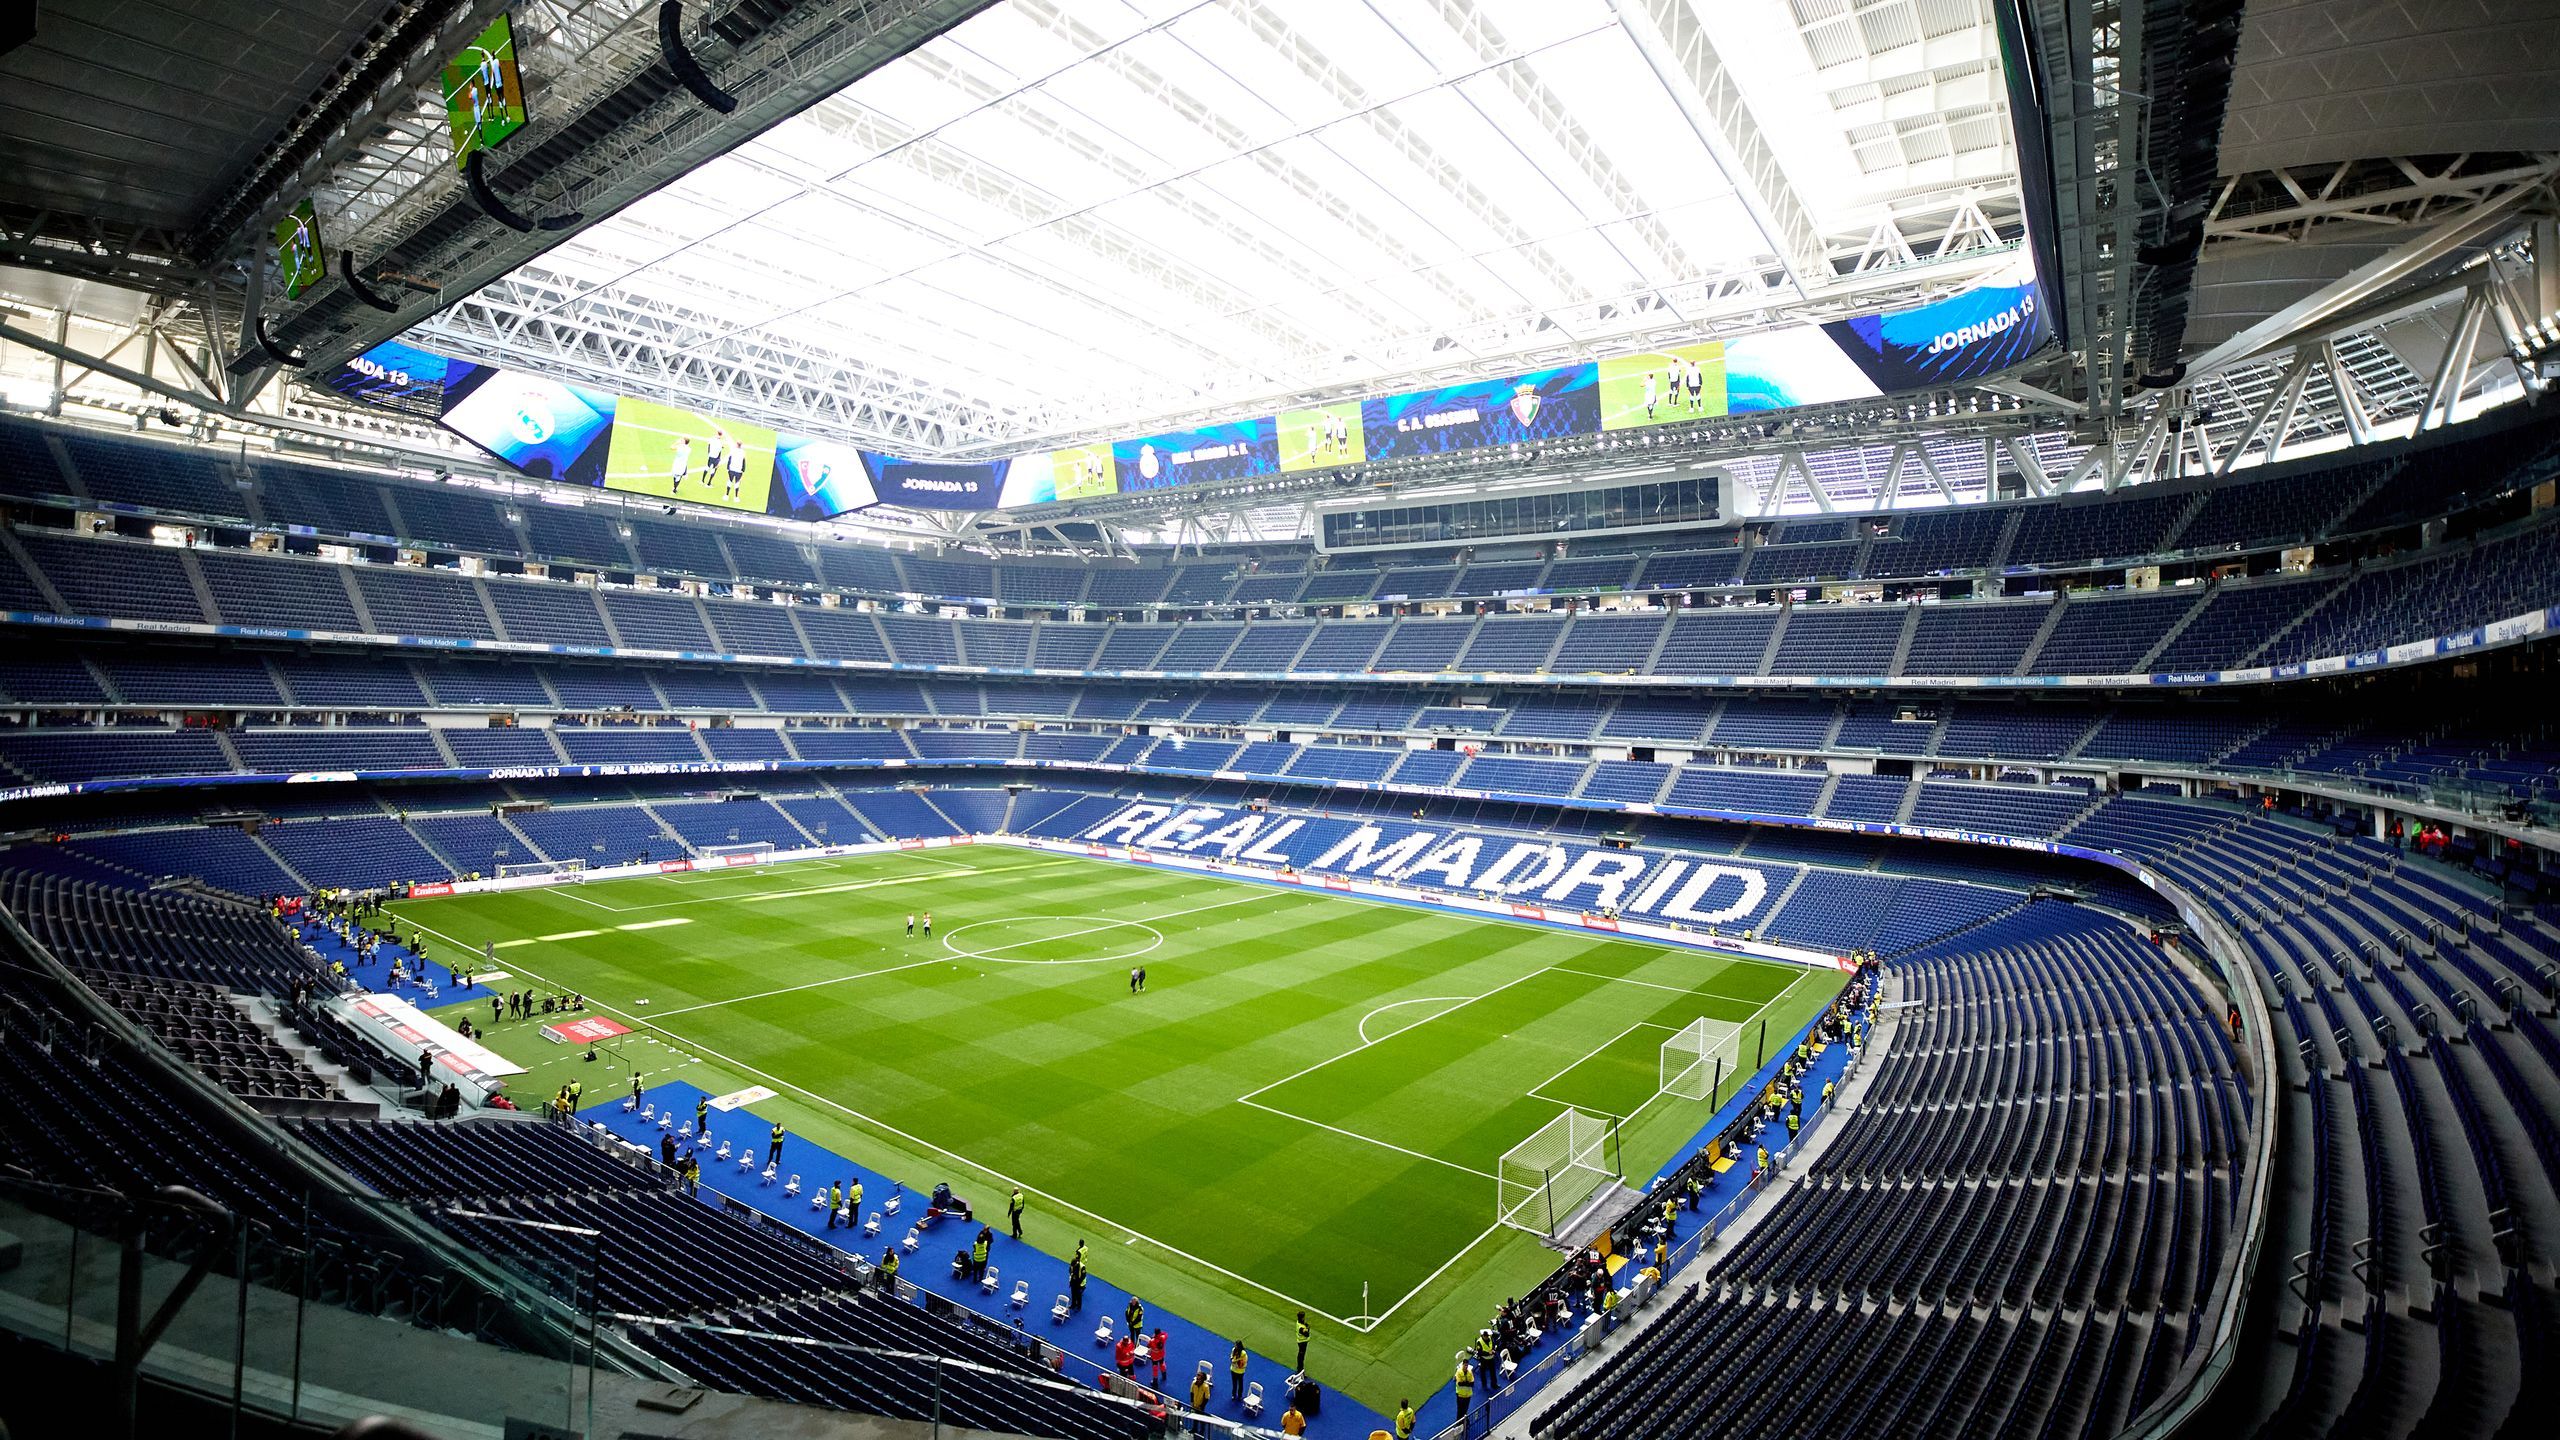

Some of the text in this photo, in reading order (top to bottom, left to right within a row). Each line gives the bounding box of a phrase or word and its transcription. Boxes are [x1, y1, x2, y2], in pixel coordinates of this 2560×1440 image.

[1928, 294, 2035, 354] JORNADA 13
[389, 370, 409, 386] 13
[902, 478, 978, 492] JORNADA 13
[33, 615, 84, 625] Real Madrid
[137, 622, 190, 632] Real Madrid
[240, 627, 288, 637] Real Madrid
[332, 634, 377, 643] Real Madrid
[418, 638, 457, 647] Real Madrid
[1846, 677, 1869, 685] Madrid
[2018, 677, 2044, 685] Madrid
[2105, 677, 2130, 685] Madrid
[2184, 674, 2205, 682] Madrid
[489, 767, 559, 779] JORNADA 13
[600, 765, 627, 776] REAL
[629, 764, 669, 775] MADRID
[670, 764, 680, 774] C.
[681, 764, 689, 774] F.
[700, 763, 710, 773] C.
[711, 763, 721, 773] A.
[15, 790, 22, 799] C.
[23, 789, 30, 798] A.
[31, 784, 70, 798] OSASUNA
[1813, 820, 1854, 831] JORNADA
[1900, 827, 1923, 836] REAL
[1925, 829, 1960, 840] MADRID
[1961, 832, 1970, 841] C.
[1972, 833, 1979, 843] F.
[1988, 835, 1998, 845] C.
[1999, 837, 2008, 847] A.
[2009, 838, 2048, 852] OSASUNA
[1085, 804, 1767, 925] REAL MADRID
[414, 885, 449, 896] Emirates
